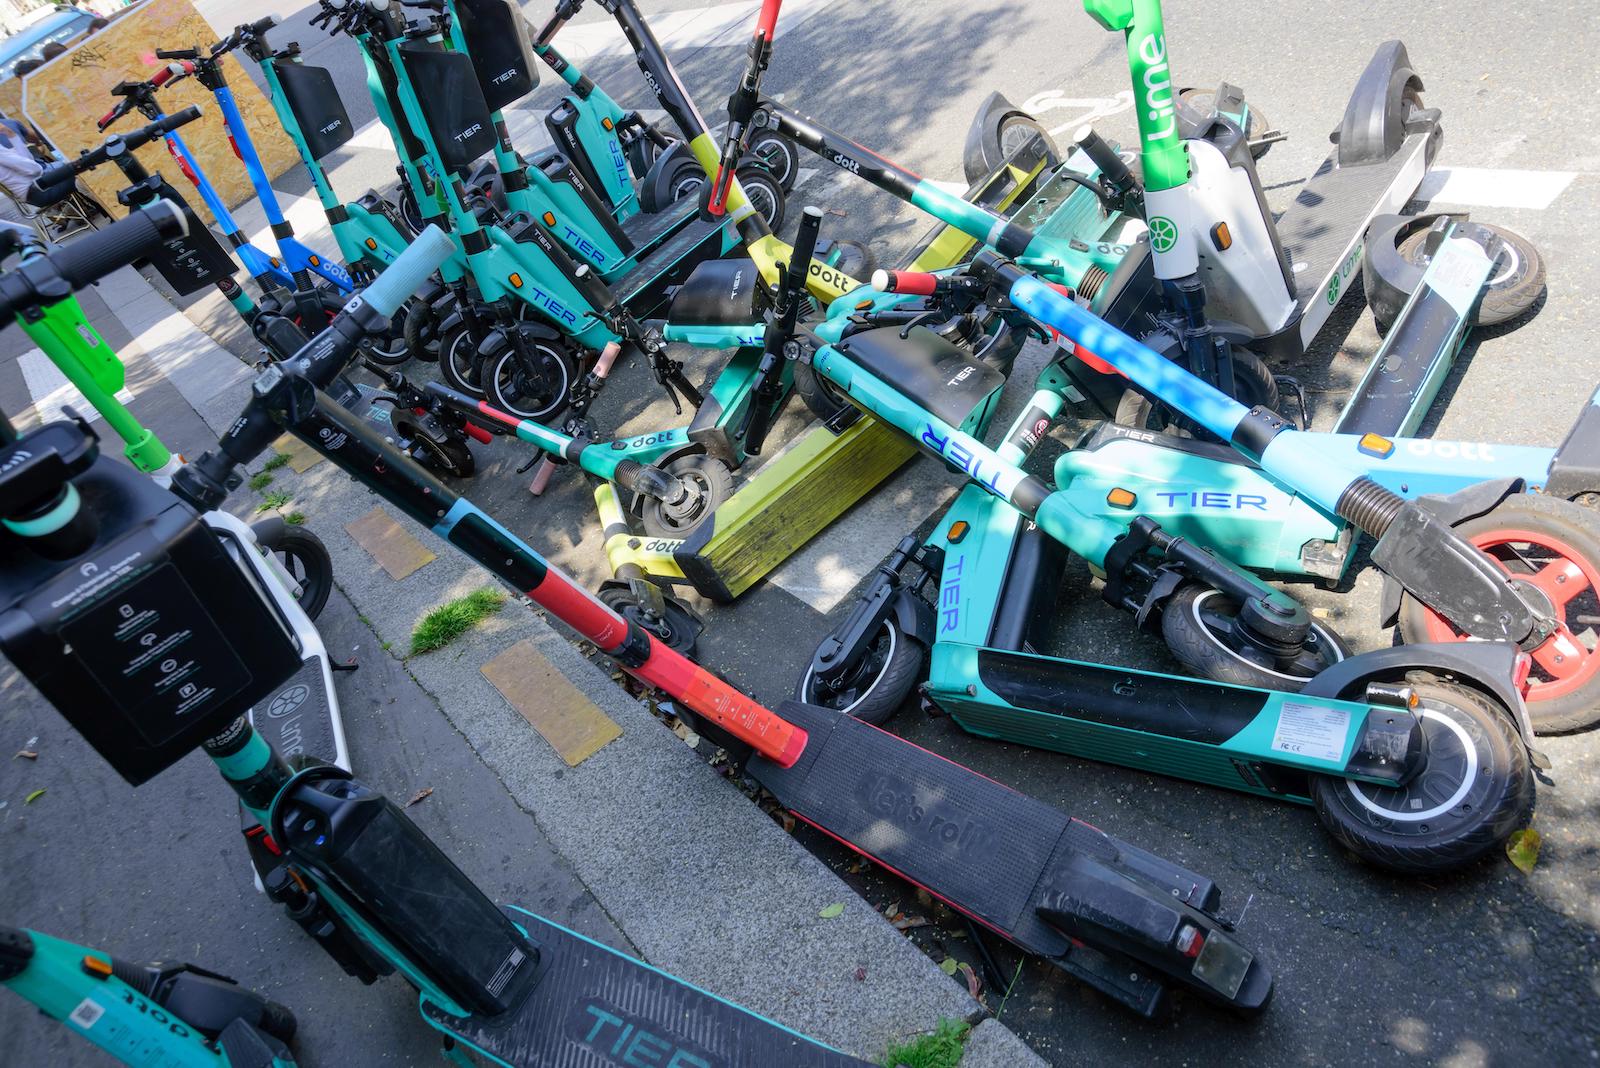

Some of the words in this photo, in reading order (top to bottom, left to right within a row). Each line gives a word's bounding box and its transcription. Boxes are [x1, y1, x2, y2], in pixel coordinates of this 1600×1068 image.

[492, 68, 517, 86] TIER
[644, 71, 661, 97] dott
[1138, 32, 1176, 142] Lime
[320, 119, 341, 135] TIER
[454, 123, 483, 144] TIER
[564, 126, 577, 149] TIER
[611, 140, 628, 187] TIER
[833, 153, 860, 174] dott
[568, 169, 584, 191] TIER
[381, 204, 396, 223] TIER
[534, 228, 552, 251] TIER
[565, 226, 605, 264] TIER
[1342, 243, 1362, 279] Lime
[323, 263, 349, 283] dott
[730, 269, 742, 299] TIER
[810, 264, 848, 292] dott
[533, 287, 576, 325] TIER
[947, 366, 976, 386] TIER
[632, 431, 673, 449] dott
[1112, 426, 1155, 441] TIER
[921, 422, 1006, 499] TIER
[1407, 440, 1495, 462] dott
[1156, 492, 1268, 511] TIER
[941, 555, 964, 634] TIER
[123, 988, 189, 1038] dott
